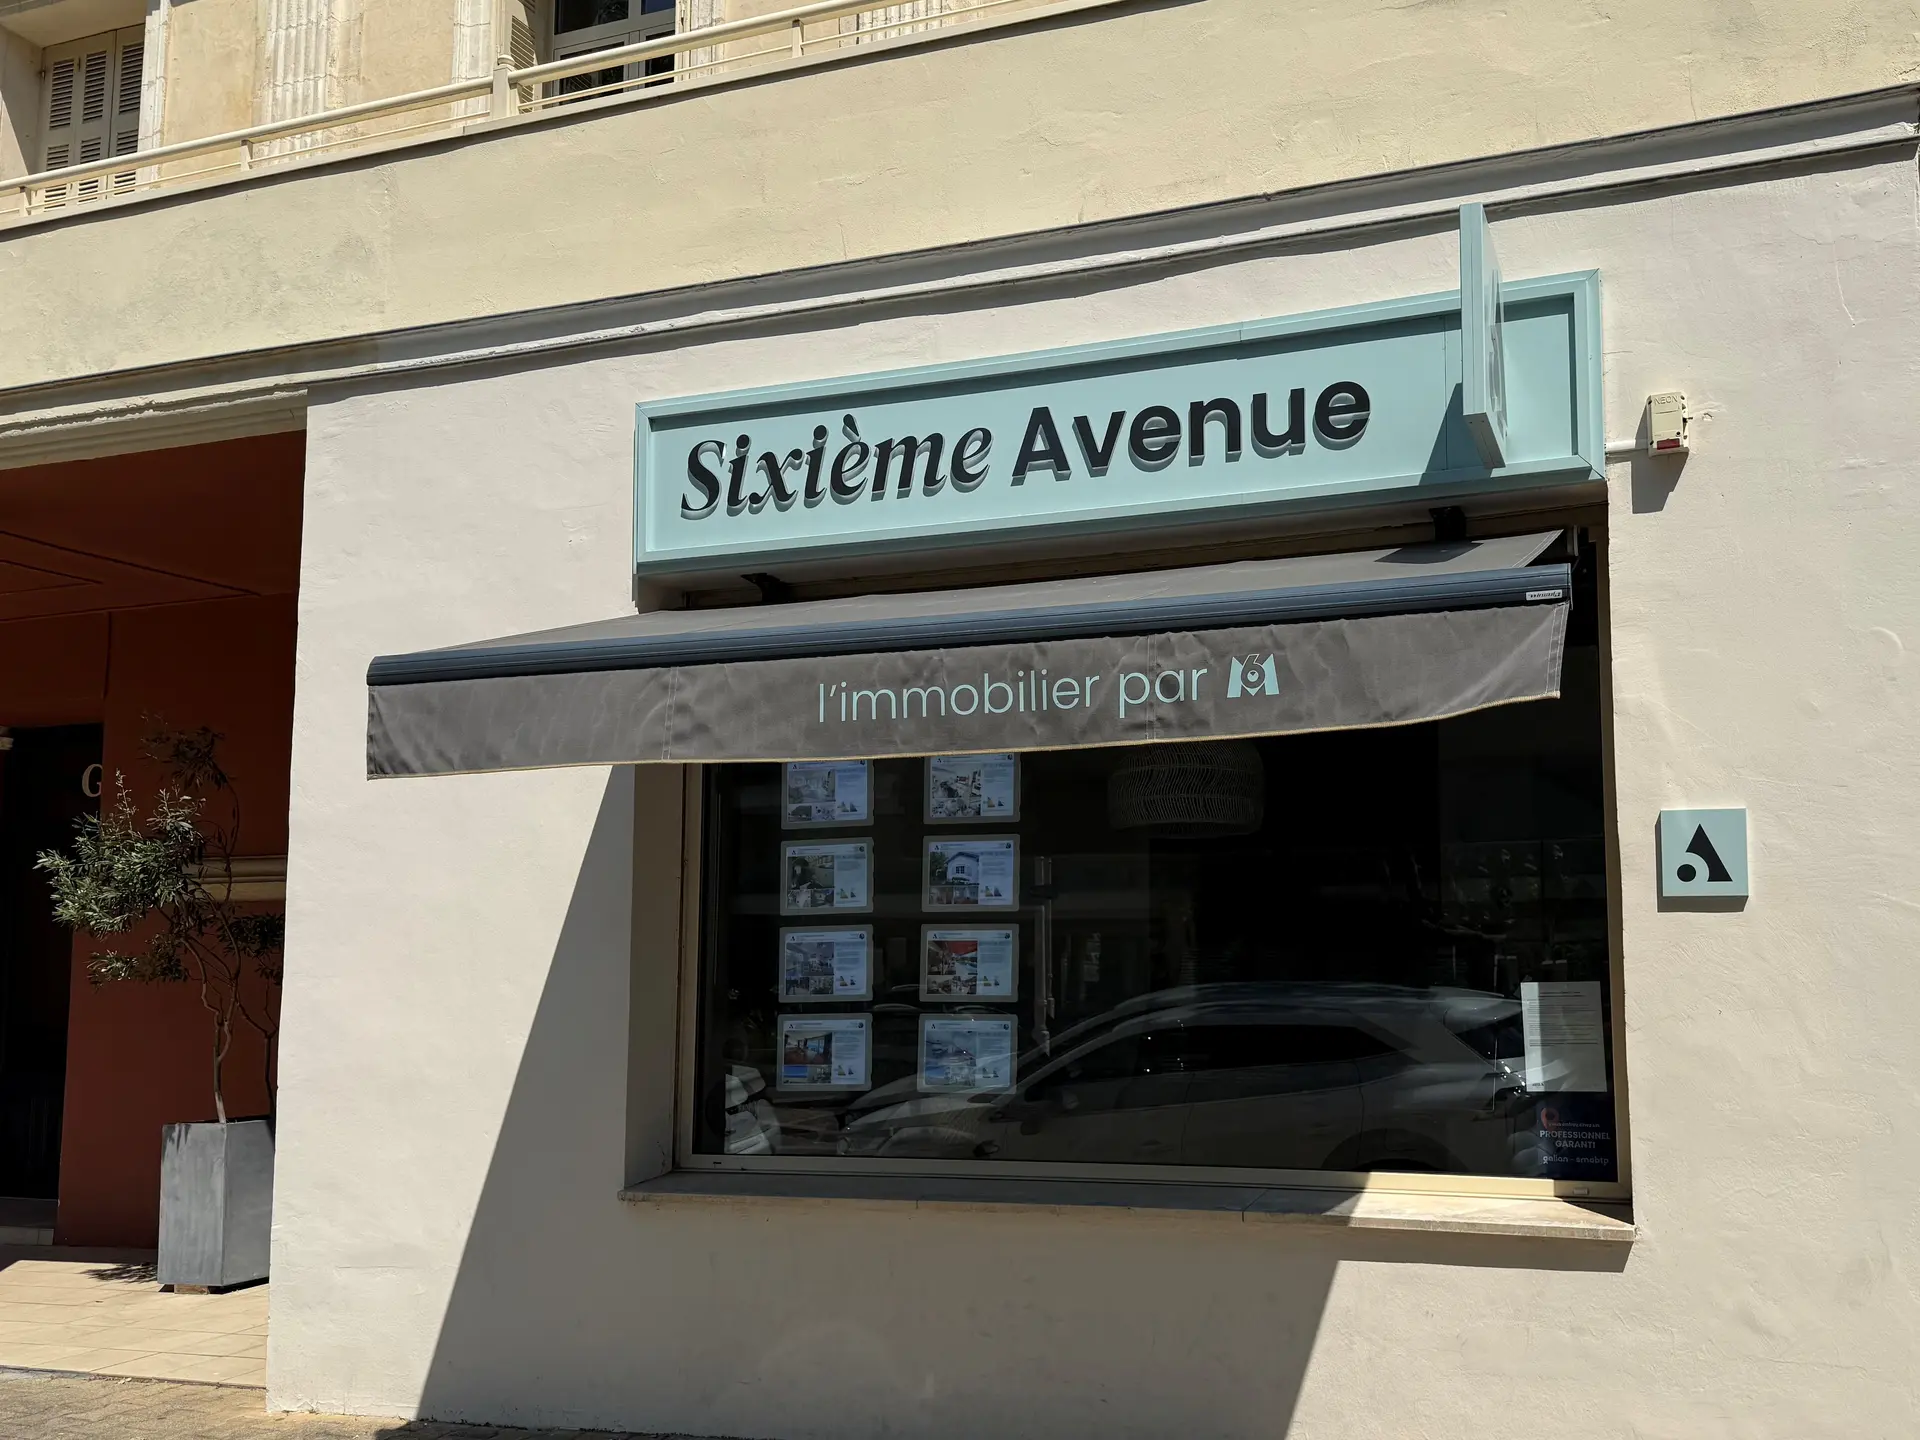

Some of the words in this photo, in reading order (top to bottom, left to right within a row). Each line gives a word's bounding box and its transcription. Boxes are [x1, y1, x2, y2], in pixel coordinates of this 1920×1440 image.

[681, 413, 992, 517] Sixième
[1011, 381, 1371, 484] Avenue
[818, 669, 1100, 722] l'immobilier
[1118, 667, 1208, 719] par
[1539, 1130, 1610, 1140] PROFESSIONNEL
[1555, 1140, 1596, 1149] GARANTI
